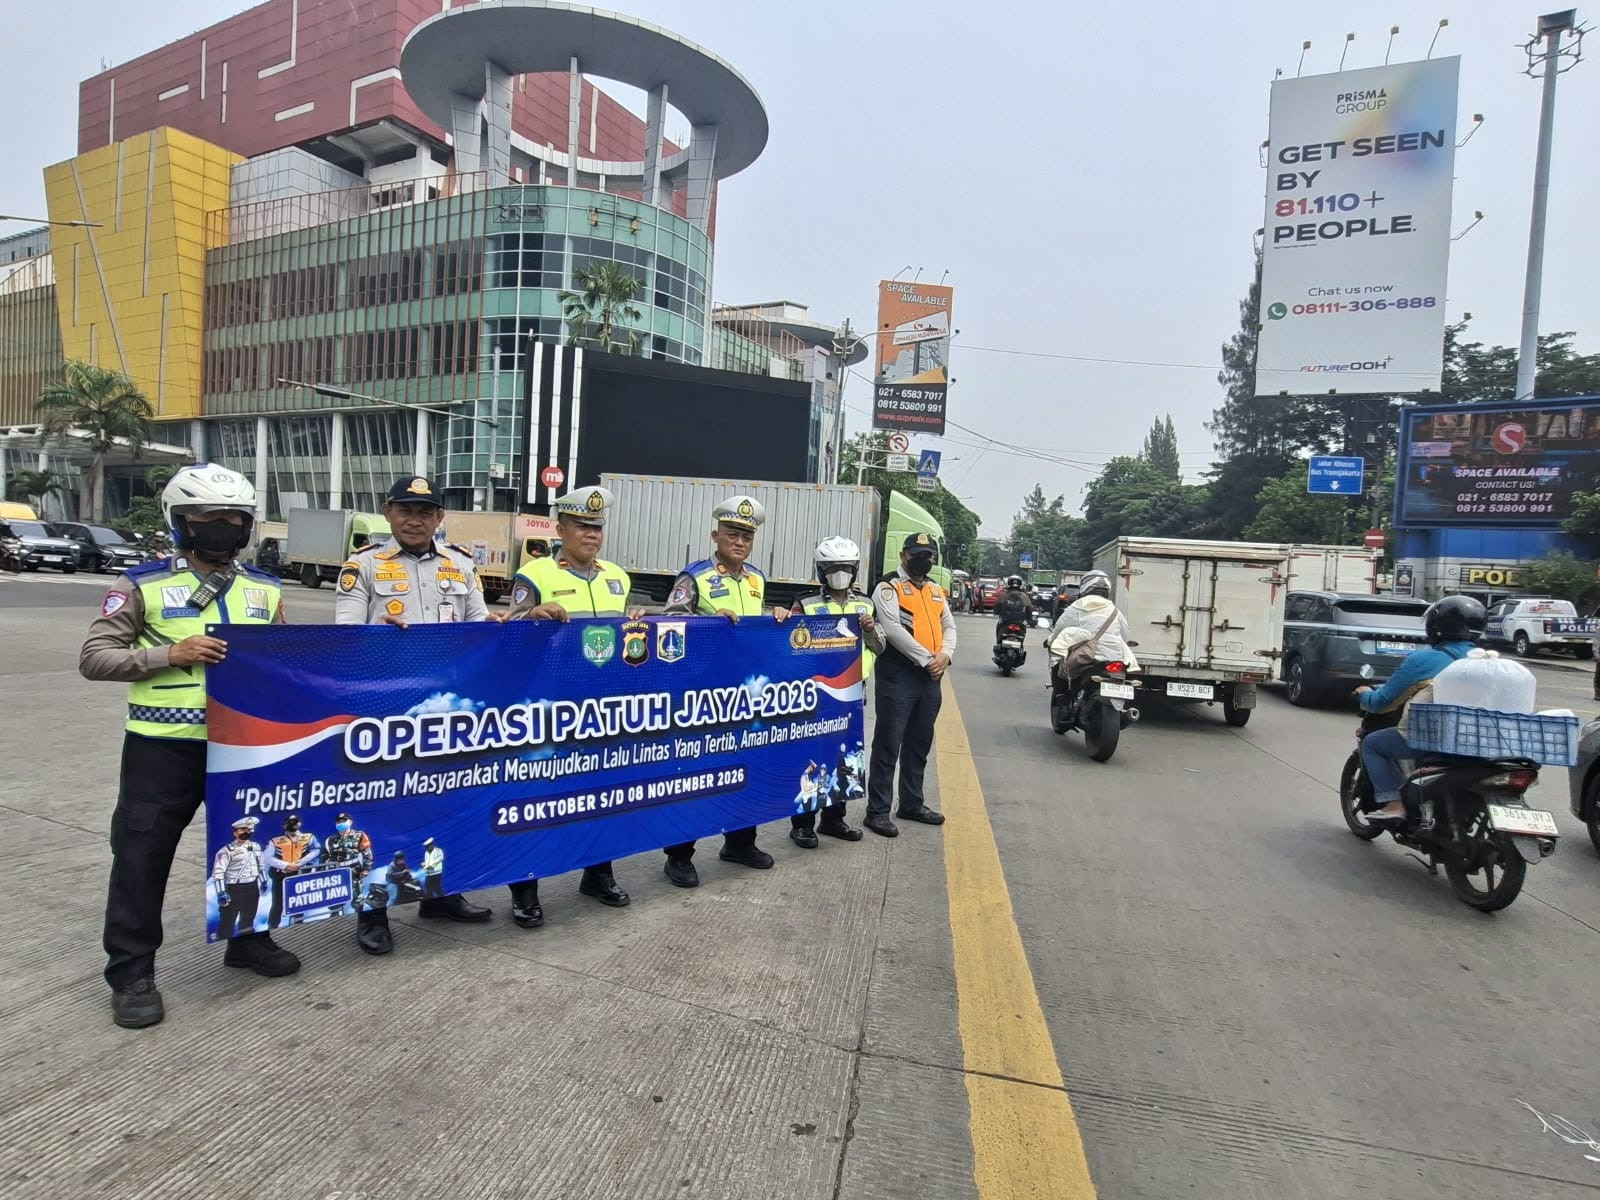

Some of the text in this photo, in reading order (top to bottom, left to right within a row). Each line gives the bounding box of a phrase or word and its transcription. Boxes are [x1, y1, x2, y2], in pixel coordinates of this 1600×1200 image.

[1336, 100, 1386, 114] GROUP
[1278, 130, 1444, 164] GET SEEN
[1277, 170, 1321, 192] BY
[1273, 215, 1416, 244] PEOPLE.
[886, 283, 916, 294] SPACE
[1308, 284, 1394, 298] Chat us now
[901, 294, 948, 306] AVAILABLE
[1292, 296, 1436, 315] 08111-306-888
[878, 388, 894, 396] 021
[902, 389, 922, 399] 6583
[924, 392, 944, 400] 7017
[878, 400, 898, 409] 0812
[928, 404, 942, 412] 991
[1456, 467, 1560, 478] SPACE AVAILABLE
[1520, 480, 1536, 488] US!
[1458, 493, 1478, 502] 021
[1490, 492, 1520, 502] 6583
[1522, 492, 1552, 502] 7017
[1456, 504, 1552, 512] 0812 53800 991
[527, 520, 550, 528] JOYKO
[1469, 569, 1518, 585] POL
[1560, 624, 1597, 632] POLIS
[345, 679, 818, 764] OPERASI PATUH JAYA-2026
[310, 779, 396, 807] Bersama
[402, 762, 499, 796] Masyarakat
[504, 751, 599, 782] Mewujudkan
[603, 746, 630, 768] Lalu
[632, 743, 670, 764] Lintas
[674, 737, 700, 758] Yang
[704, 732, 738, 754] Tertib,
[740, 730, 768, 748] Aman
[770, 728, 788, 744] Dan
[498, 768, 744, 825] 26 OKTOBER S/D 08 NOVEMBER 2026
[295, 874, 342, 894] OPERASI
[288, 886, 348, 908] PATUH JAYA
